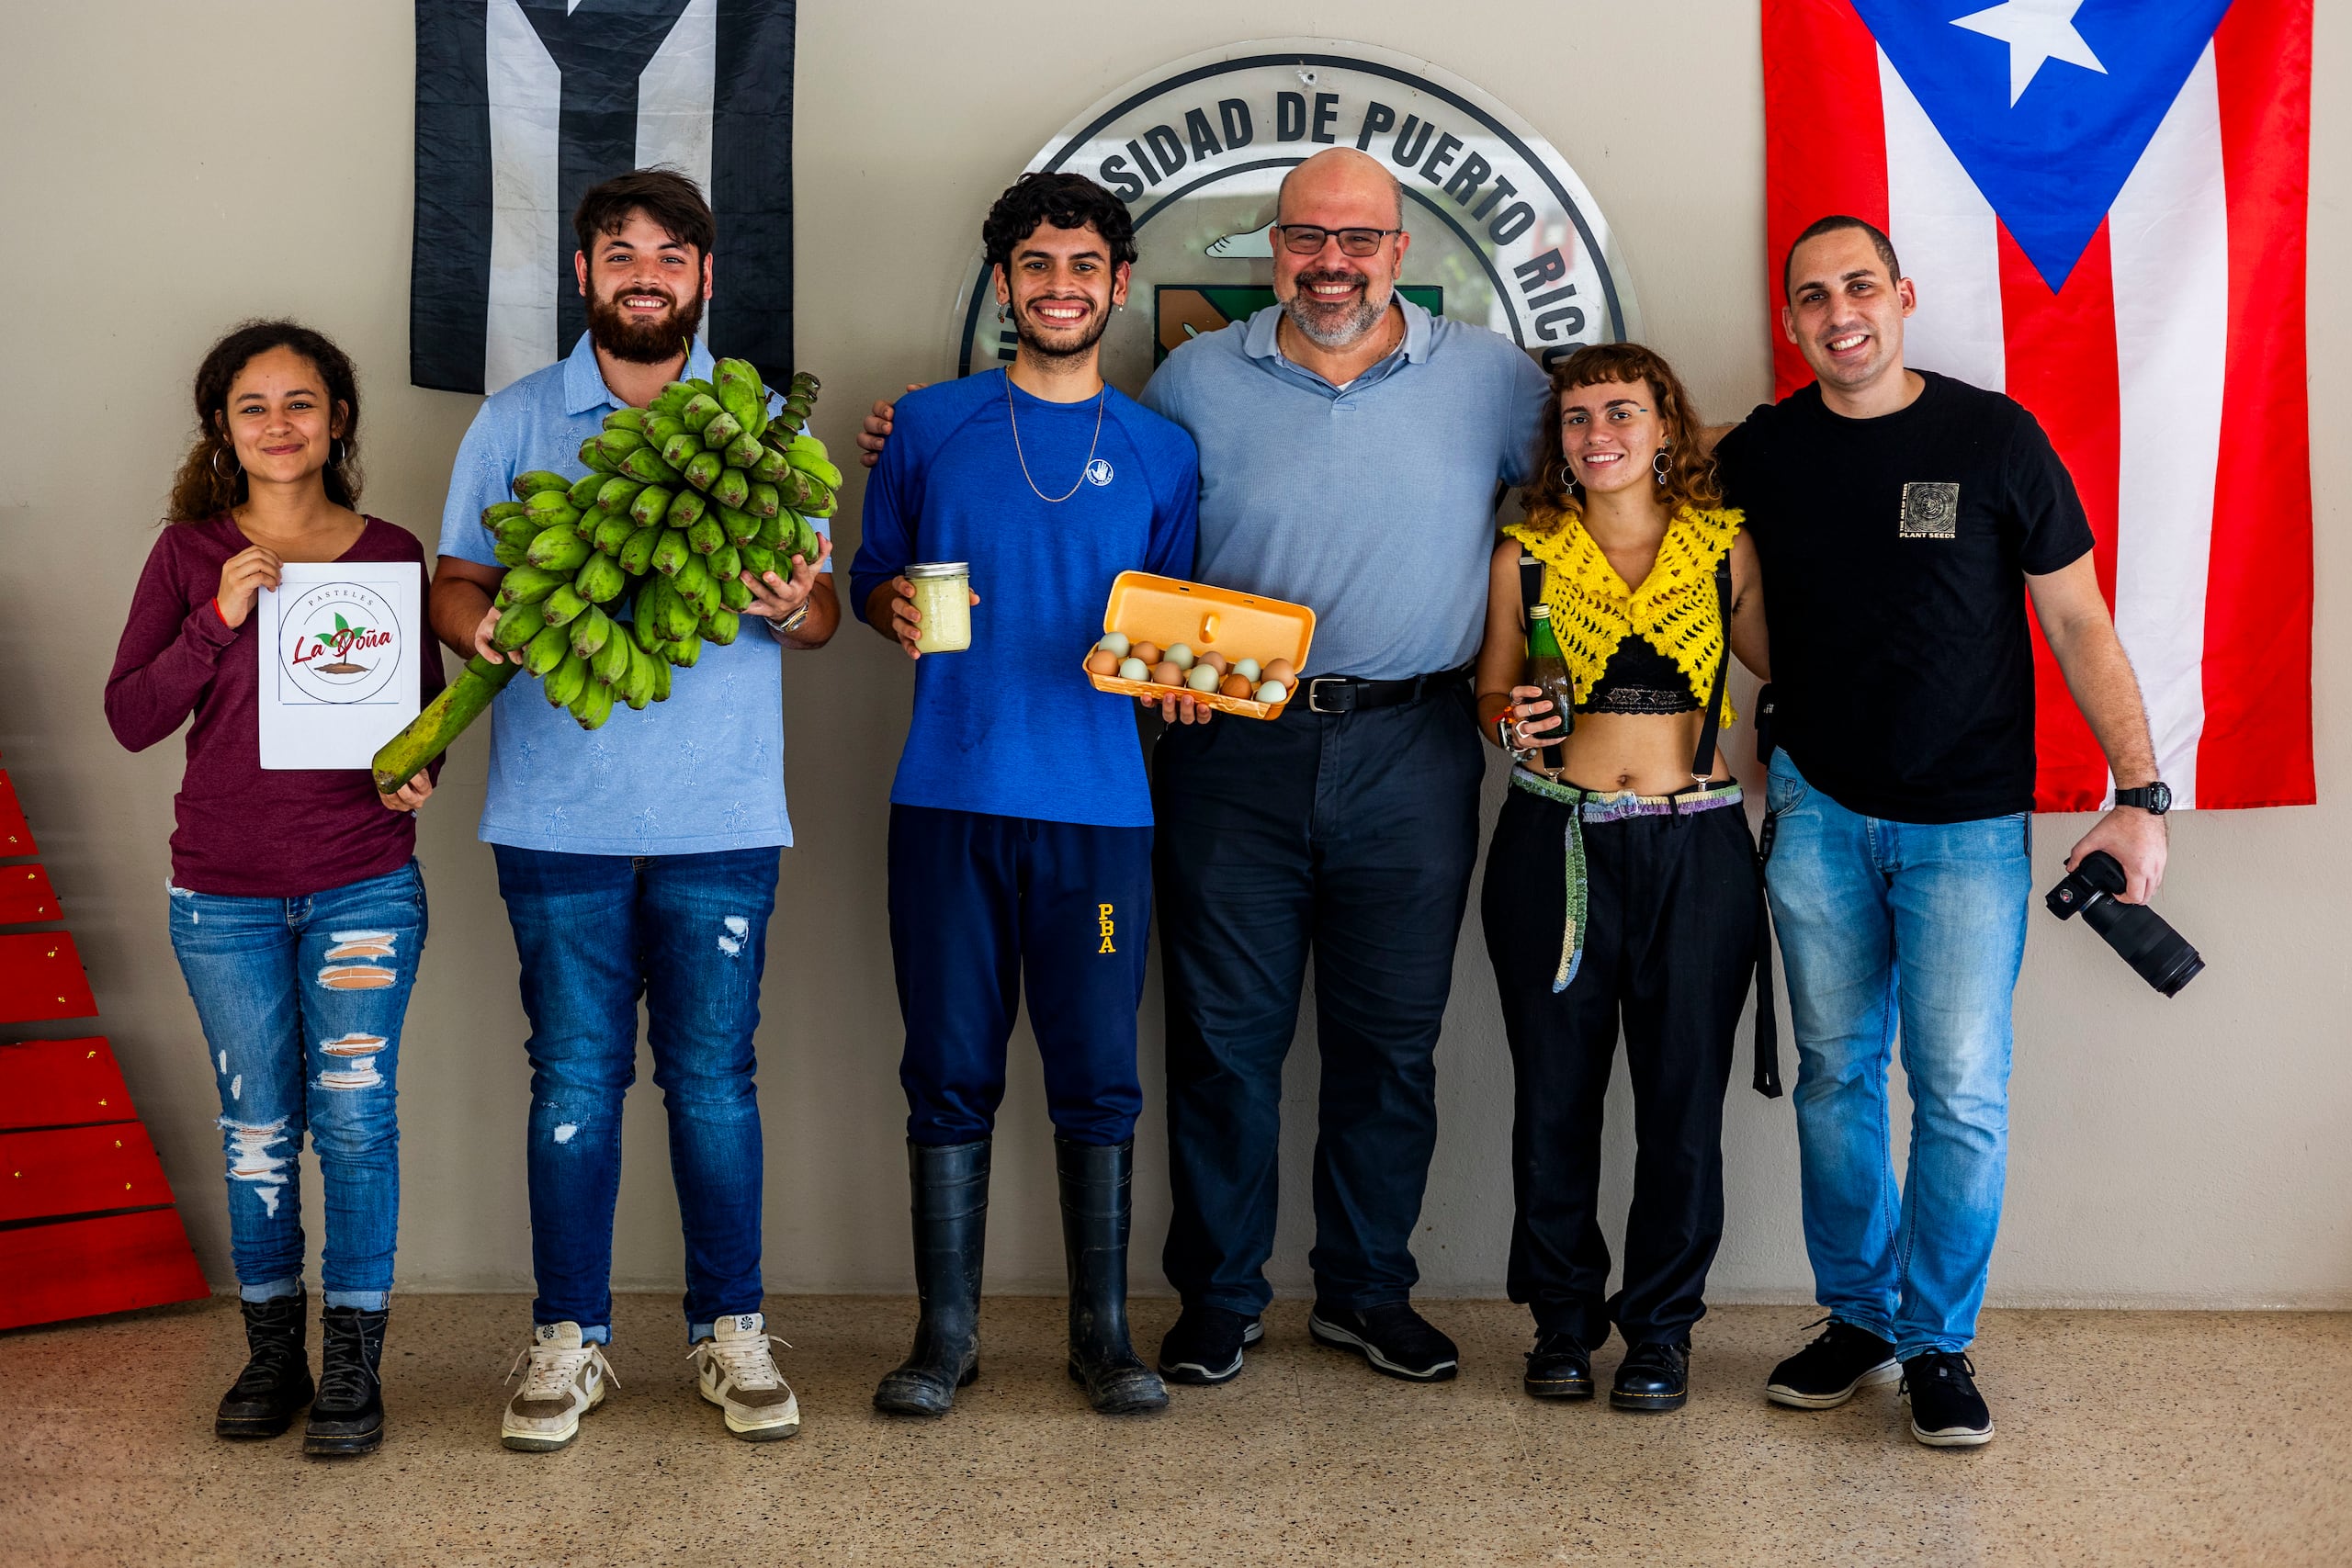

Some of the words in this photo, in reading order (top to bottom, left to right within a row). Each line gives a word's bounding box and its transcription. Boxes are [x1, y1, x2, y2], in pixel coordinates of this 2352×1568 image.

[1277, 92, 1339, 144] DE
[1356, 101, 1536, 245] PUERTO
[308, 590, 374, 606] PASTELES
[292, 636, 326, 665] La
[330, 627, 394, 658] Doña
